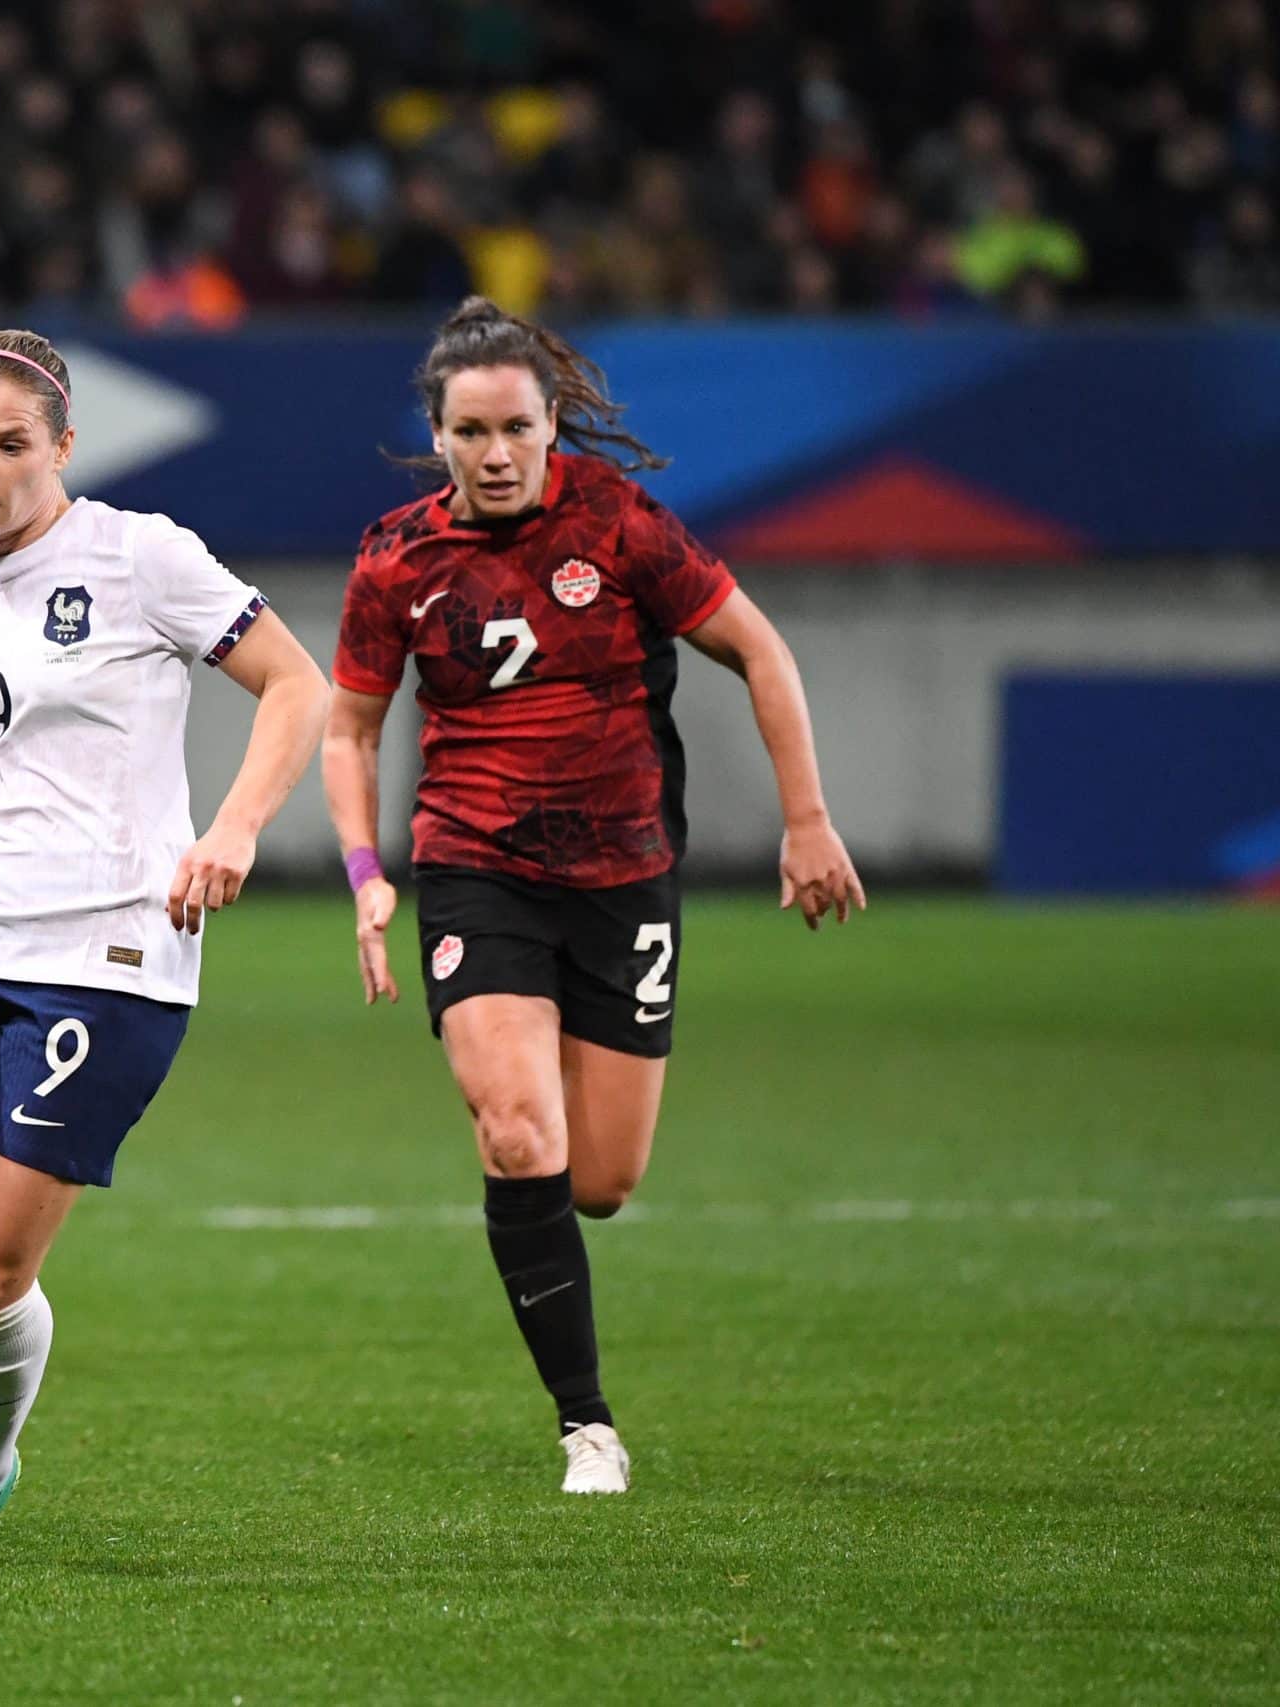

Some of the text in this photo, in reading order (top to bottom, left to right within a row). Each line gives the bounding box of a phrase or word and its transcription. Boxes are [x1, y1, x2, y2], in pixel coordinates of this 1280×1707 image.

[481, 617, 539, 689] 2
[634, 922, 673, 1003] 2
[32, 1018, 90, 1097] 9
